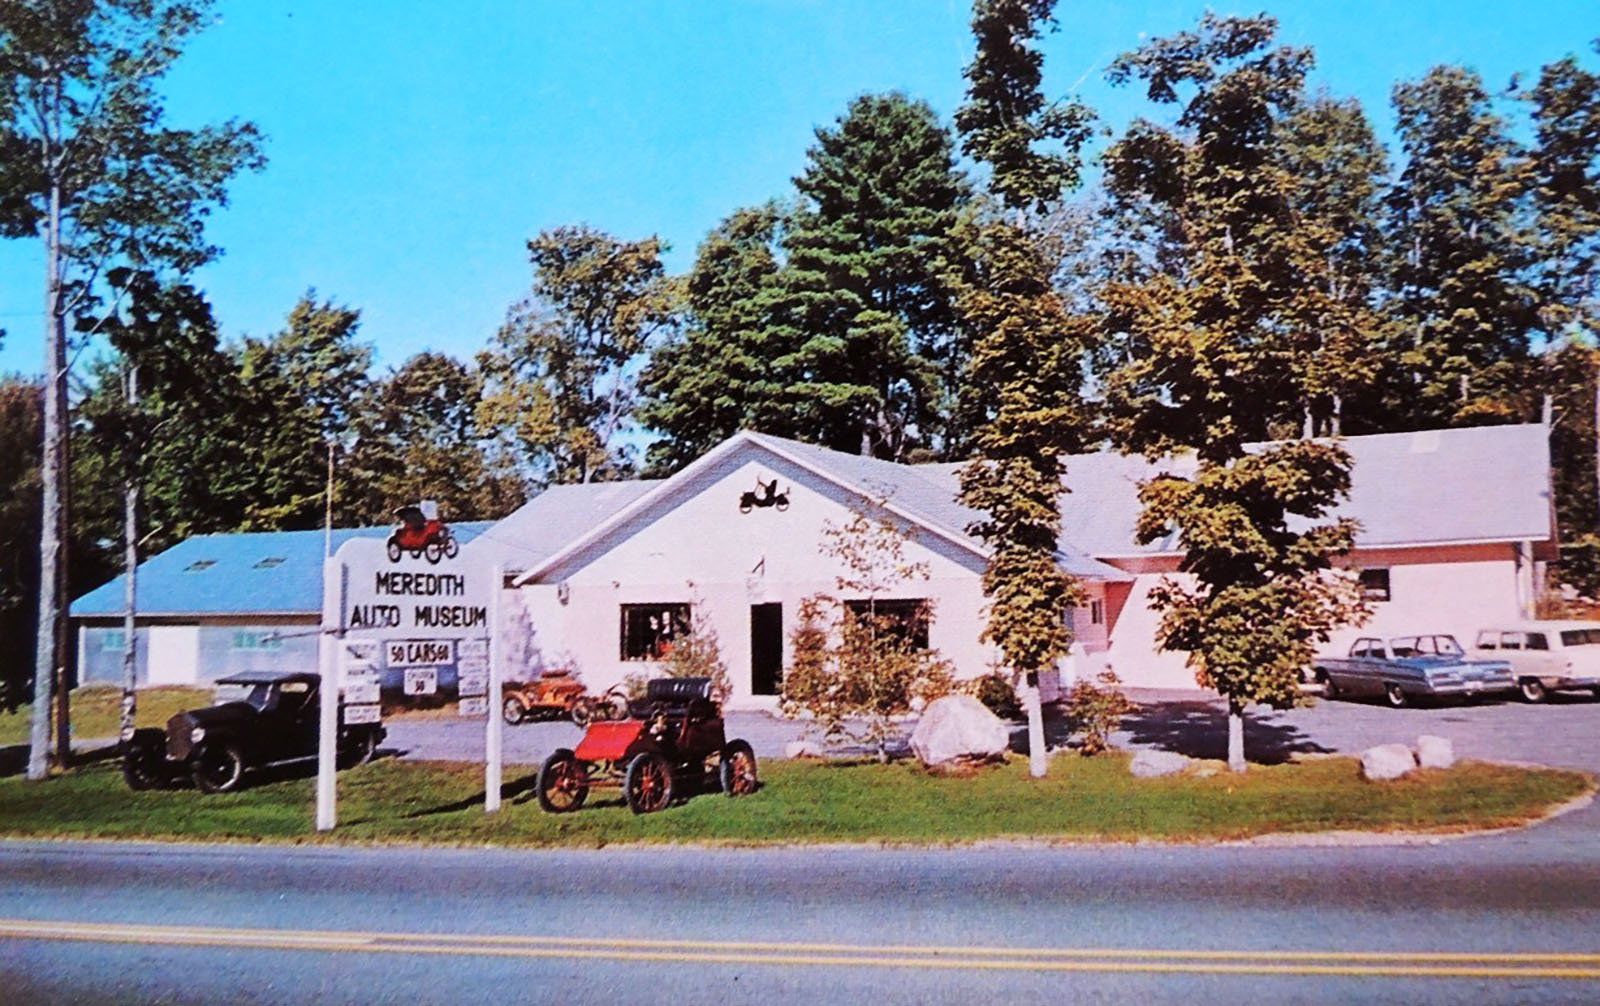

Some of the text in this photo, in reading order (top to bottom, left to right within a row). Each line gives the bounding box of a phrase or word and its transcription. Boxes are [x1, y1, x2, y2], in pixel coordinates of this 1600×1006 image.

[375, 572, 464, 596] MEREDITH
[350, 605, 487, 627] AUTO MUSEUM
[408, 644, 436, 663] CARS
